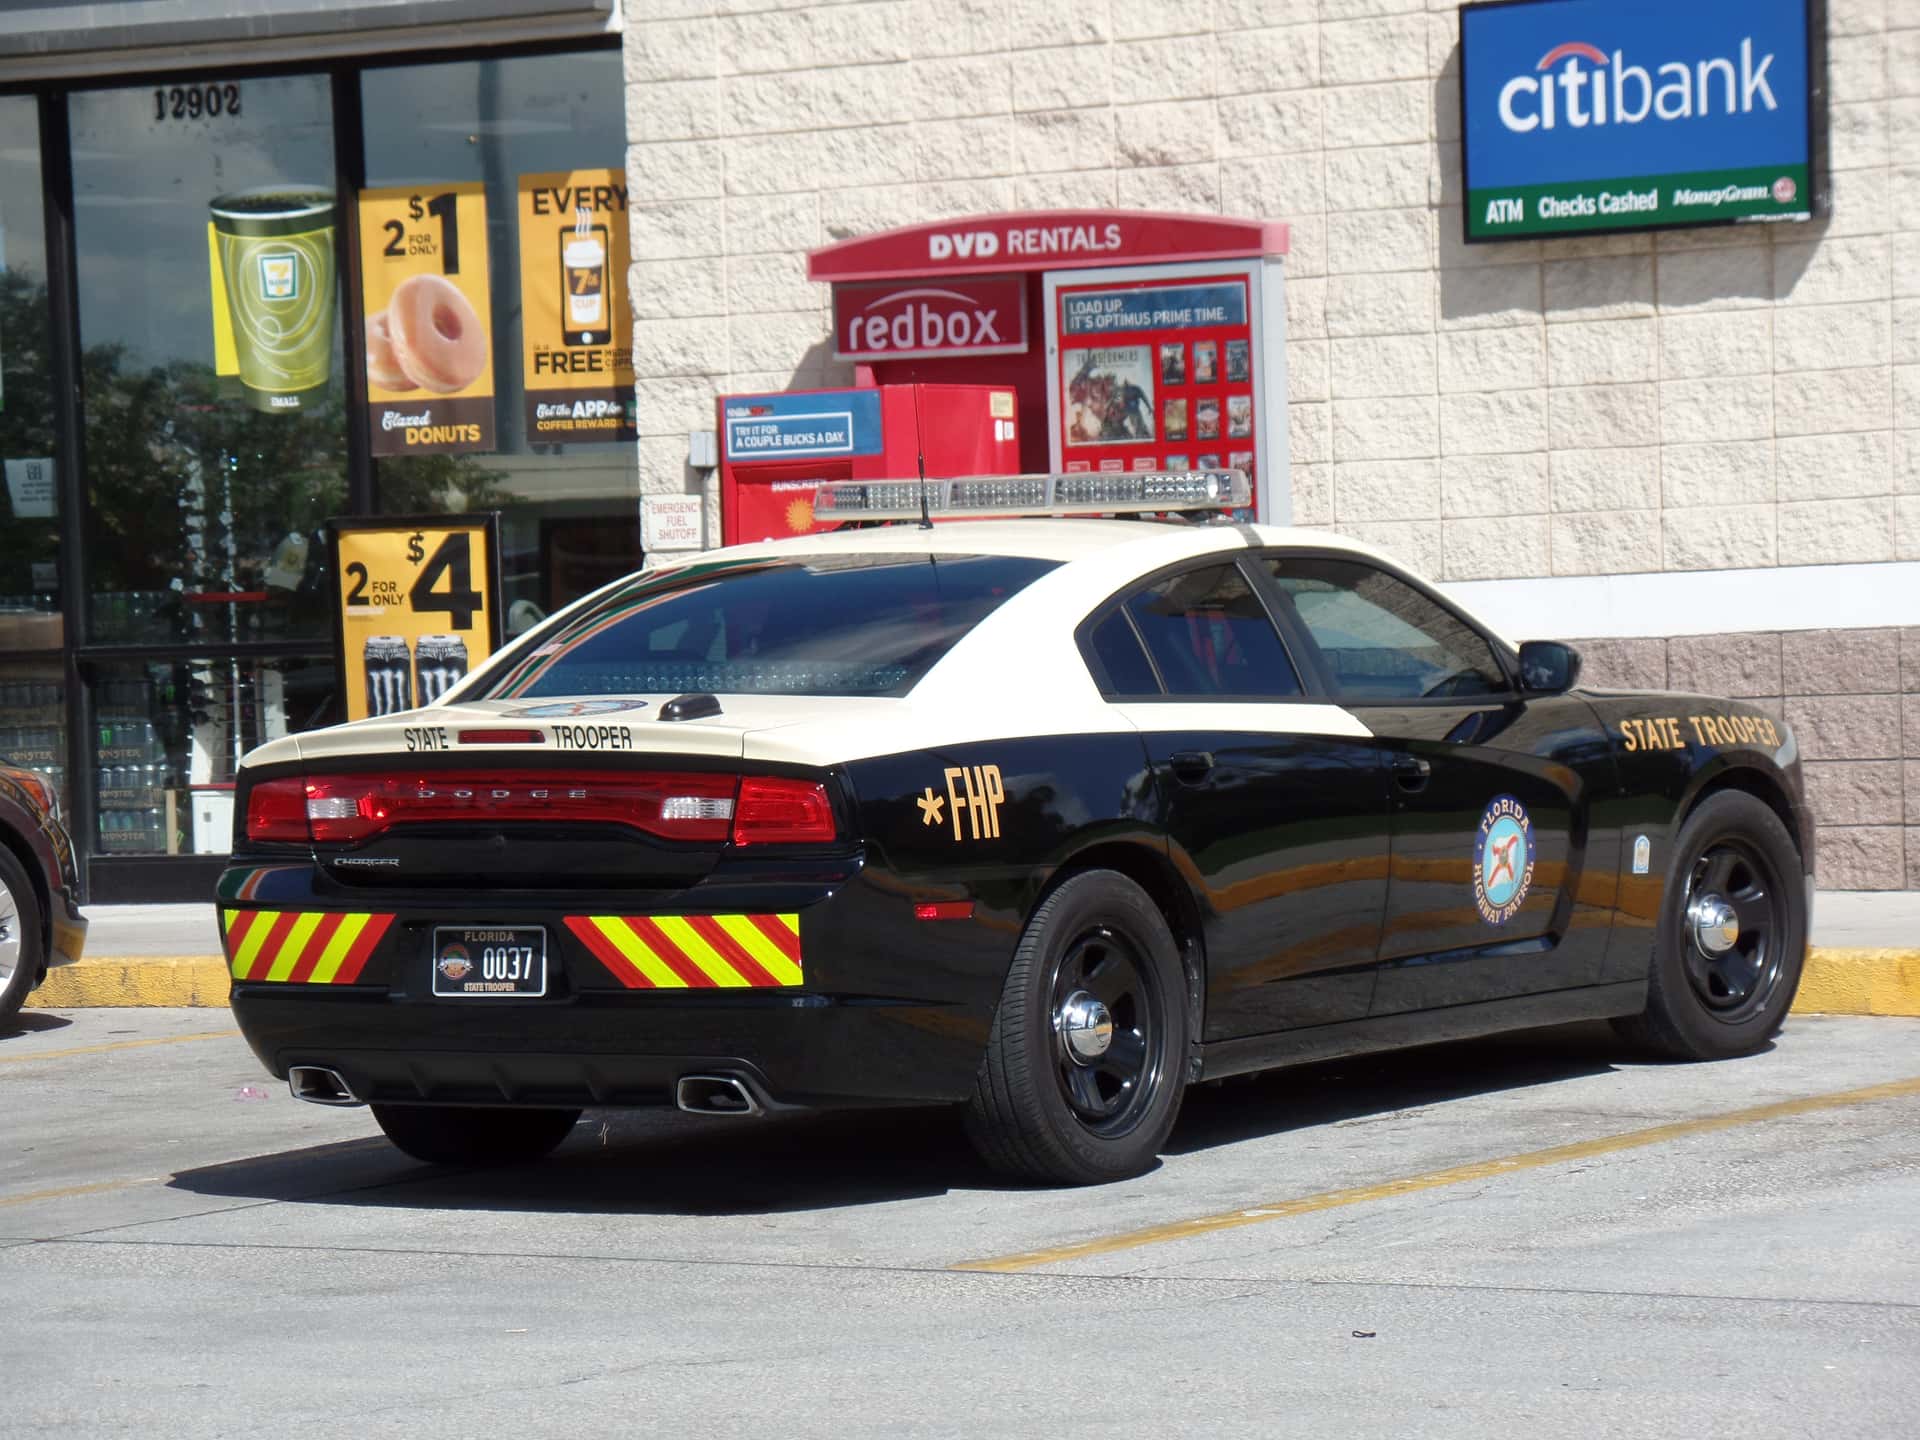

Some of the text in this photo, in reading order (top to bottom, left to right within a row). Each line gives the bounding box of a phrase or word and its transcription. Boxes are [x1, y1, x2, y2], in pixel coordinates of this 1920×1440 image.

[1499, 37, 1778, 132] citibank
[154, 84, 242, 121] 12902
[532, 184, 628, 215] EVERY
[1486, 184, 1768, 224] ATM Checks Cashed MoneyGram
[383, 219, 431, 257] 2 FOR
[929, 224, 1122, 260] DVD RENTALS
[409, 245, 438, 256] ONLY
[1070, 299, 1123, 315] LOAD UP.
[1070, 306, 1228, 329] IT'S OPTIMUS PRIME TIME.
[848, 303, 1002, 351] redbox
[534, 350, 603, 375] FREE
[382, 409, 431, 431] Glazed
[572, 400, 608, 418] APP
[405, 424, 481, 445] DONUTS
[536, 419, 573, 431] COFFEE
[735, 424, 778, 437] TRY IT FOR
[736, 437, 743, 448] A
[744, 434, 781, 448] COUPLE
[783, 432, 816, 446] BUCKS
[817, 432, 824, 444] A
[652, 502, 698, 514] EMERGENC
[666, 515, 688, 527] FUEL
[658, 527, 697, 540] SHUTOFF
[345, 561, 397, 606] 2 FOR
[373, 594, 404, 606] ONLY
[404, 725, 633, 751] STATE TROOPER
[1620, 714, 1781, 751] STATE TROOPER
[417, 788, 587, 799] DODGE
[1481, 799, 1530, 834] FLORIDA
[1474, 861, 1534, 924] HIGHWAY PATROL
[464, 931, 515, 942] FLORIDA
[483, 946, 532, 980] 0037
[464, 982, 515, 992] STATE TROOPER
